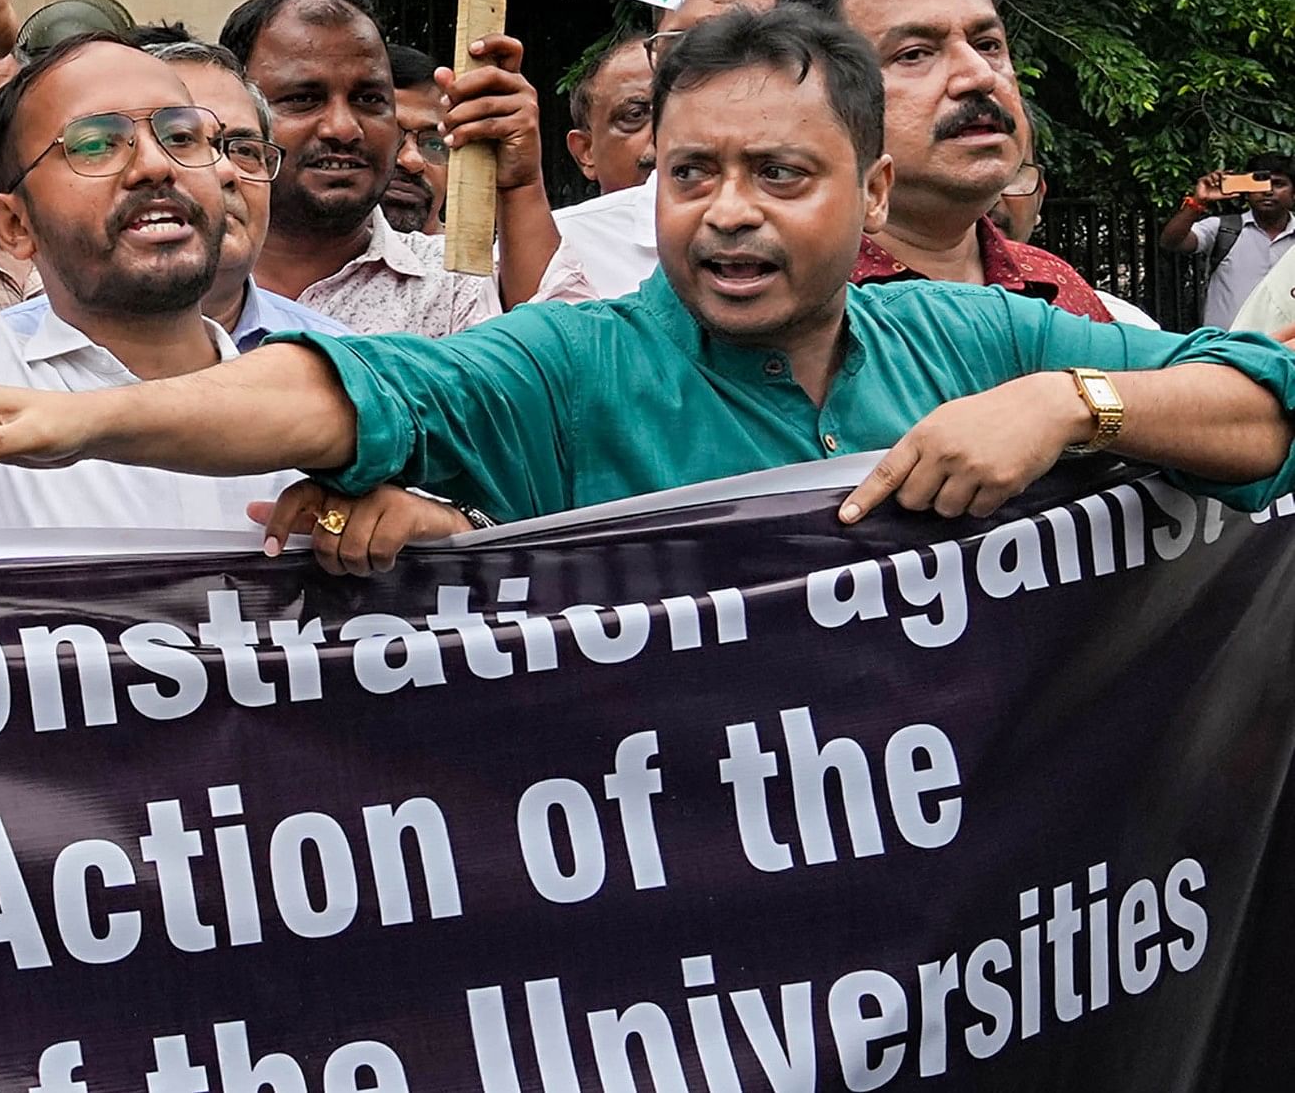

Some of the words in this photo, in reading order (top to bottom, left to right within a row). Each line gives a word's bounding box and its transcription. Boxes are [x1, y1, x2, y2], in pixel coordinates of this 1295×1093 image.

[517, 731, 667, 904] of
[719, 706, 962, 872] the
[466, 858, 1209, 1093] Universities
